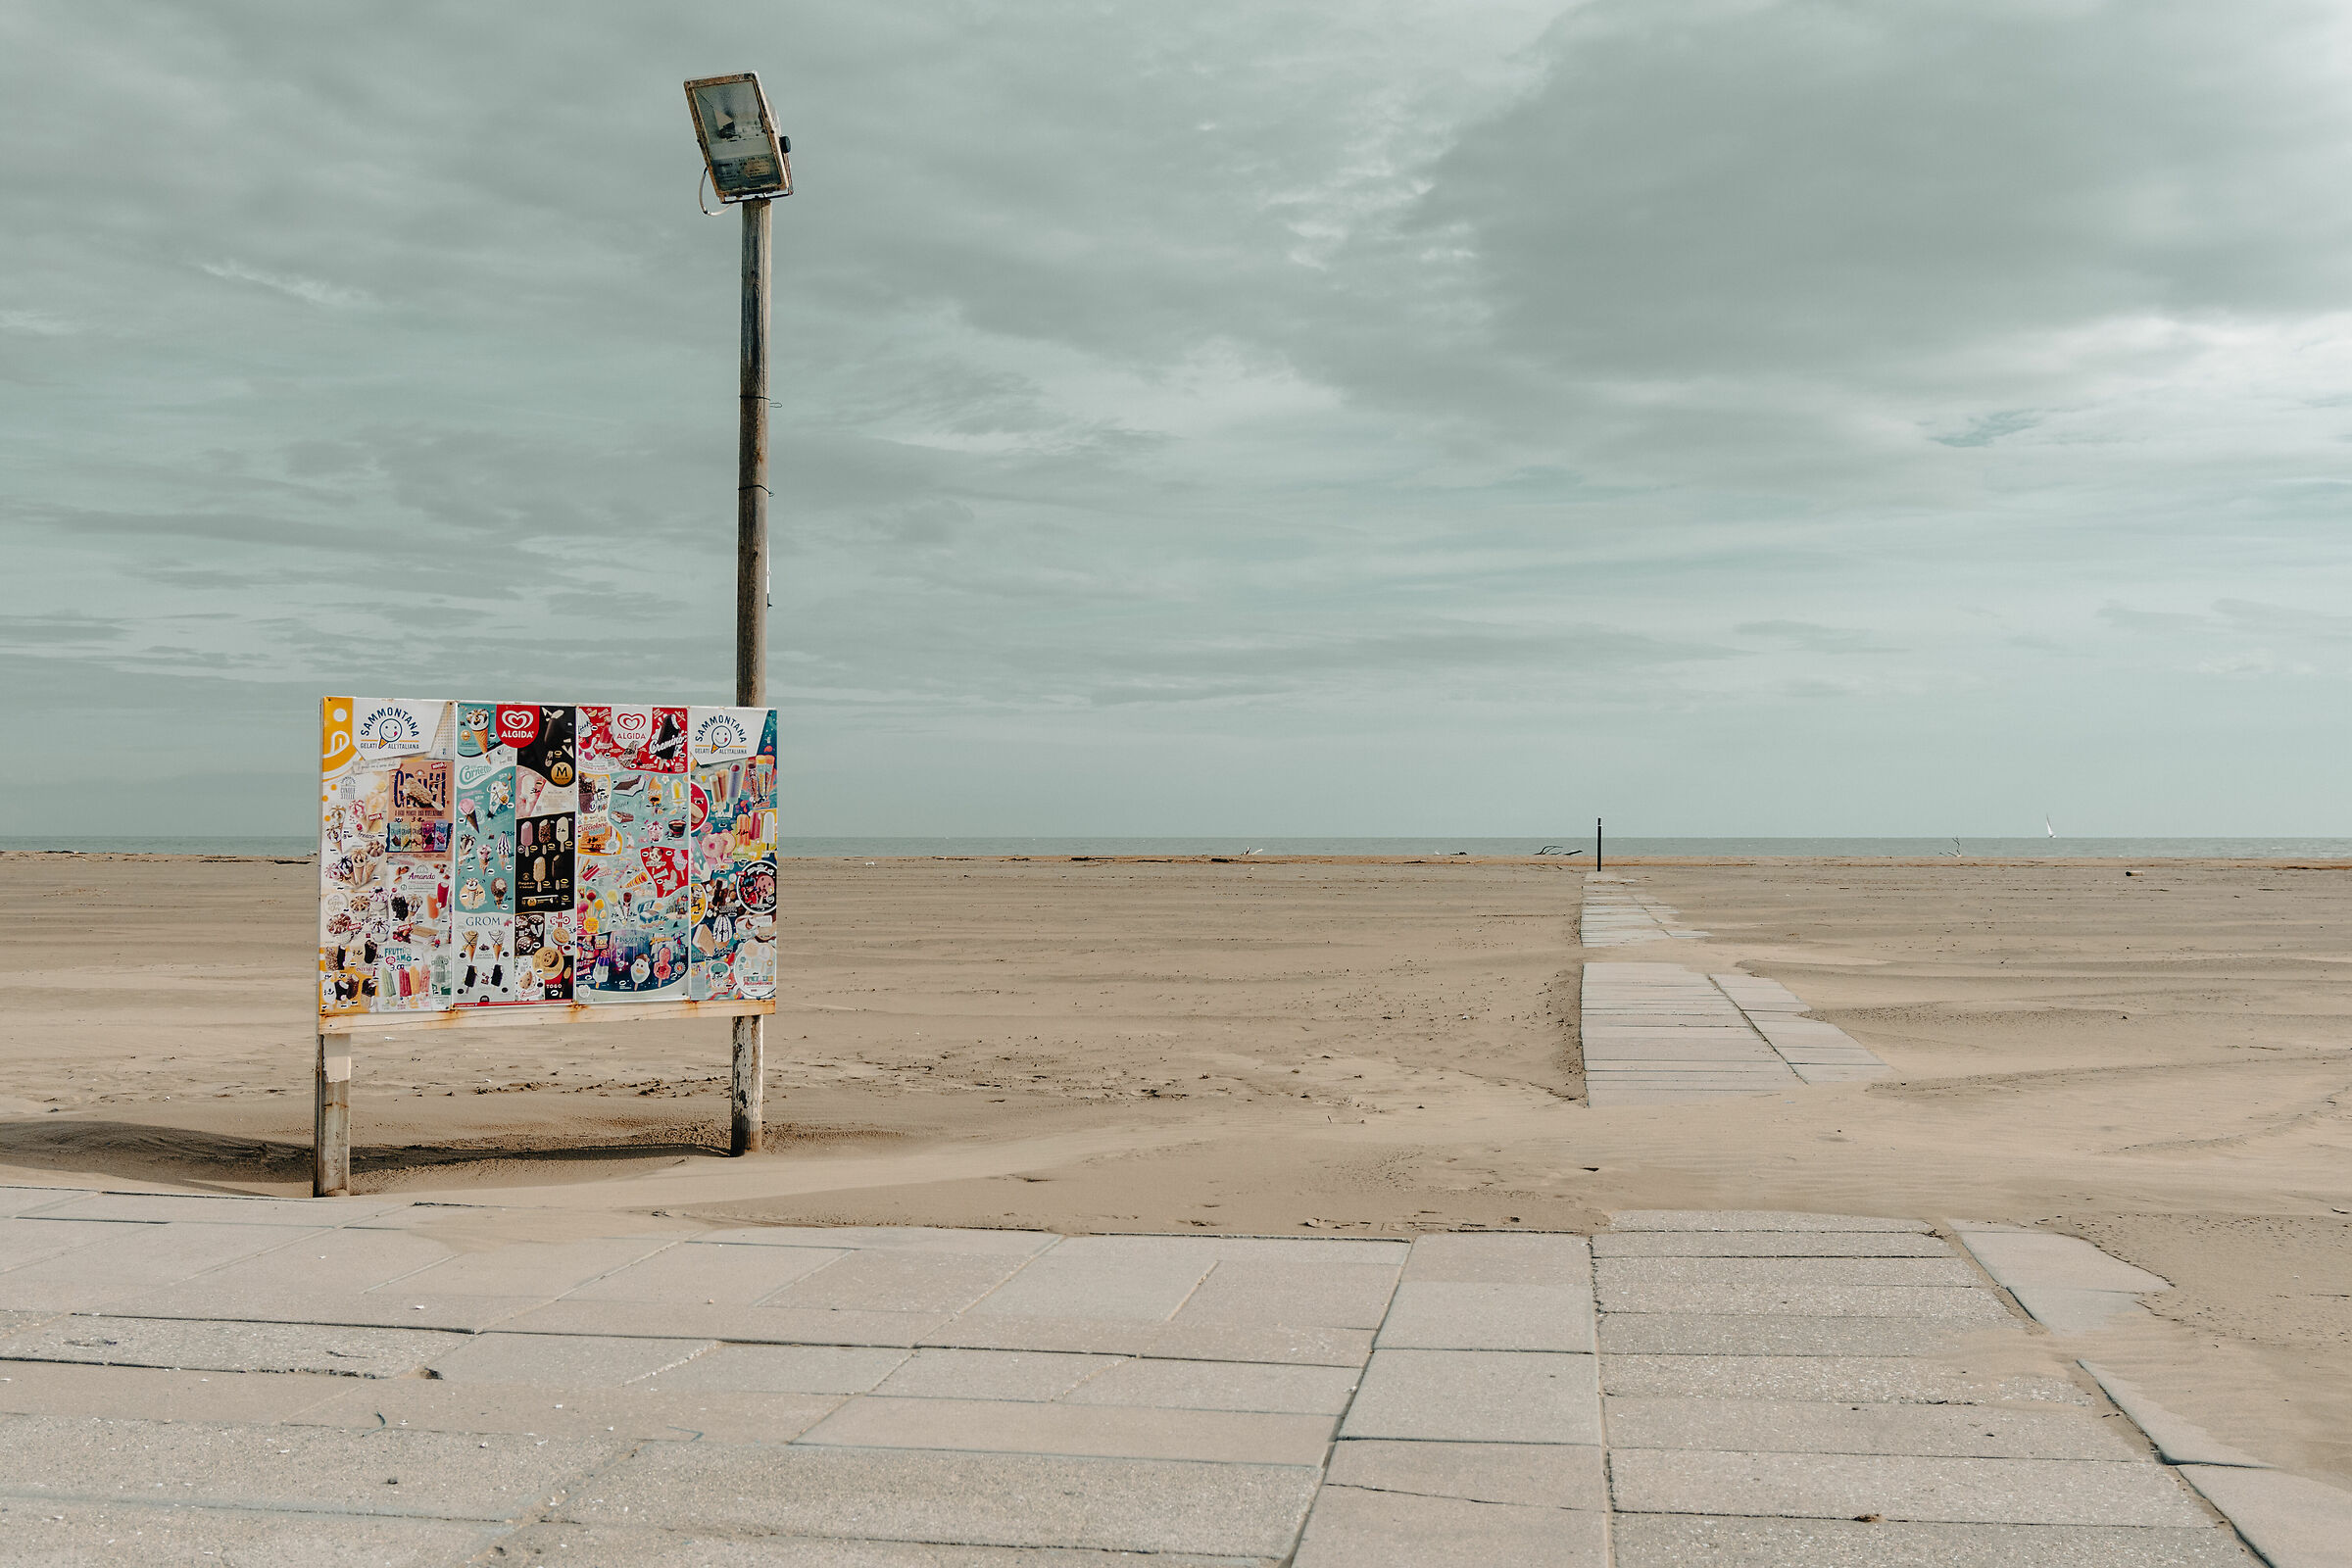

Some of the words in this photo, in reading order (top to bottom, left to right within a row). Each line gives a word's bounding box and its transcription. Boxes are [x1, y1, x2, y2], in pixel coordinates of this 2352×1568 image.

[360, 707, 420, 738] SAMMONTANA
[501, 730, 534, 739] ALGIDA
[695, 714, 748, 744] SAMMONTANA
[649, 736, 686, 755] Cremino
[556, 766, 568, 777] M
[466, 916, 501, 927] GROM
[384, 948, 405, 957] FRUTTI
